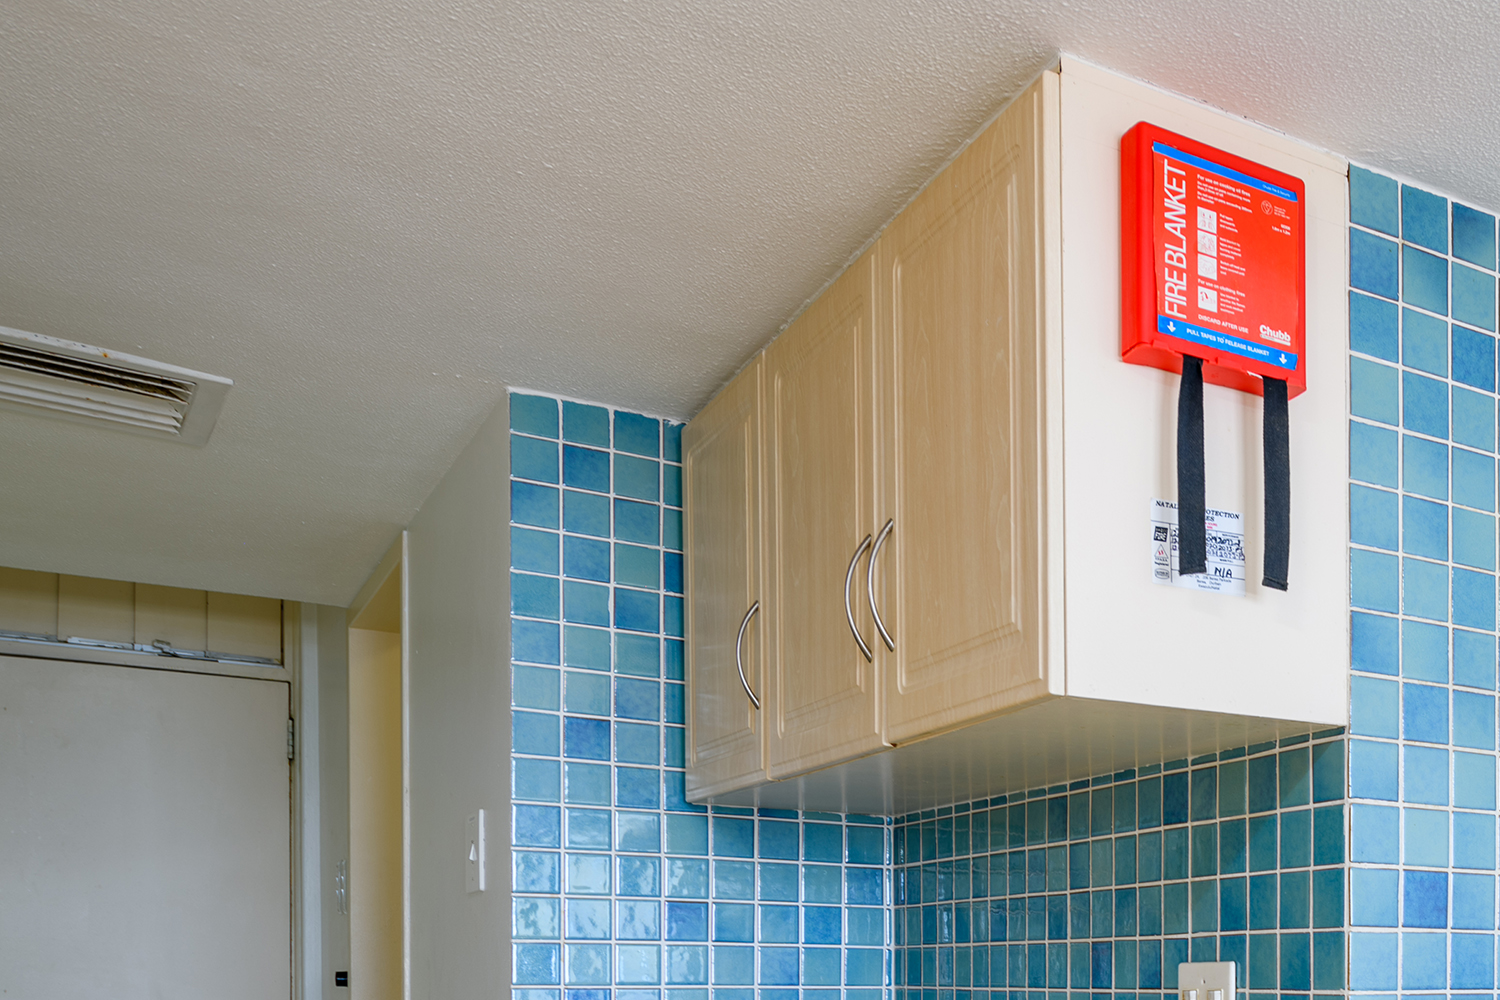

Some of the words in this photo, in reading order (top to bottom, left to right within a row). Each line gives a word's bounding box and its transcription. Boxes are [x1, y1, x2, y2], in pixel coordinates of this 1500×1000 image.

[1164, 158, 1186, 269] BLANKET
[1164, 267, 1187, 319] FIRE
[1198, 314, 1221, 326] DISCARD
[1222, 321, 1238, 331] AFTER
[1238, 326, 1249, 334] USE
[1260, 324, 1291, 342] Chubb
[1186, 328, 1200, 337] PULL
[1200, 332, 1216, 342] TAPES
[1225, 338, 1247, 350] RELEASE
[1247, 344, 1270, 356] BLANKET
[1214, 566, 1232, 578] N/A
